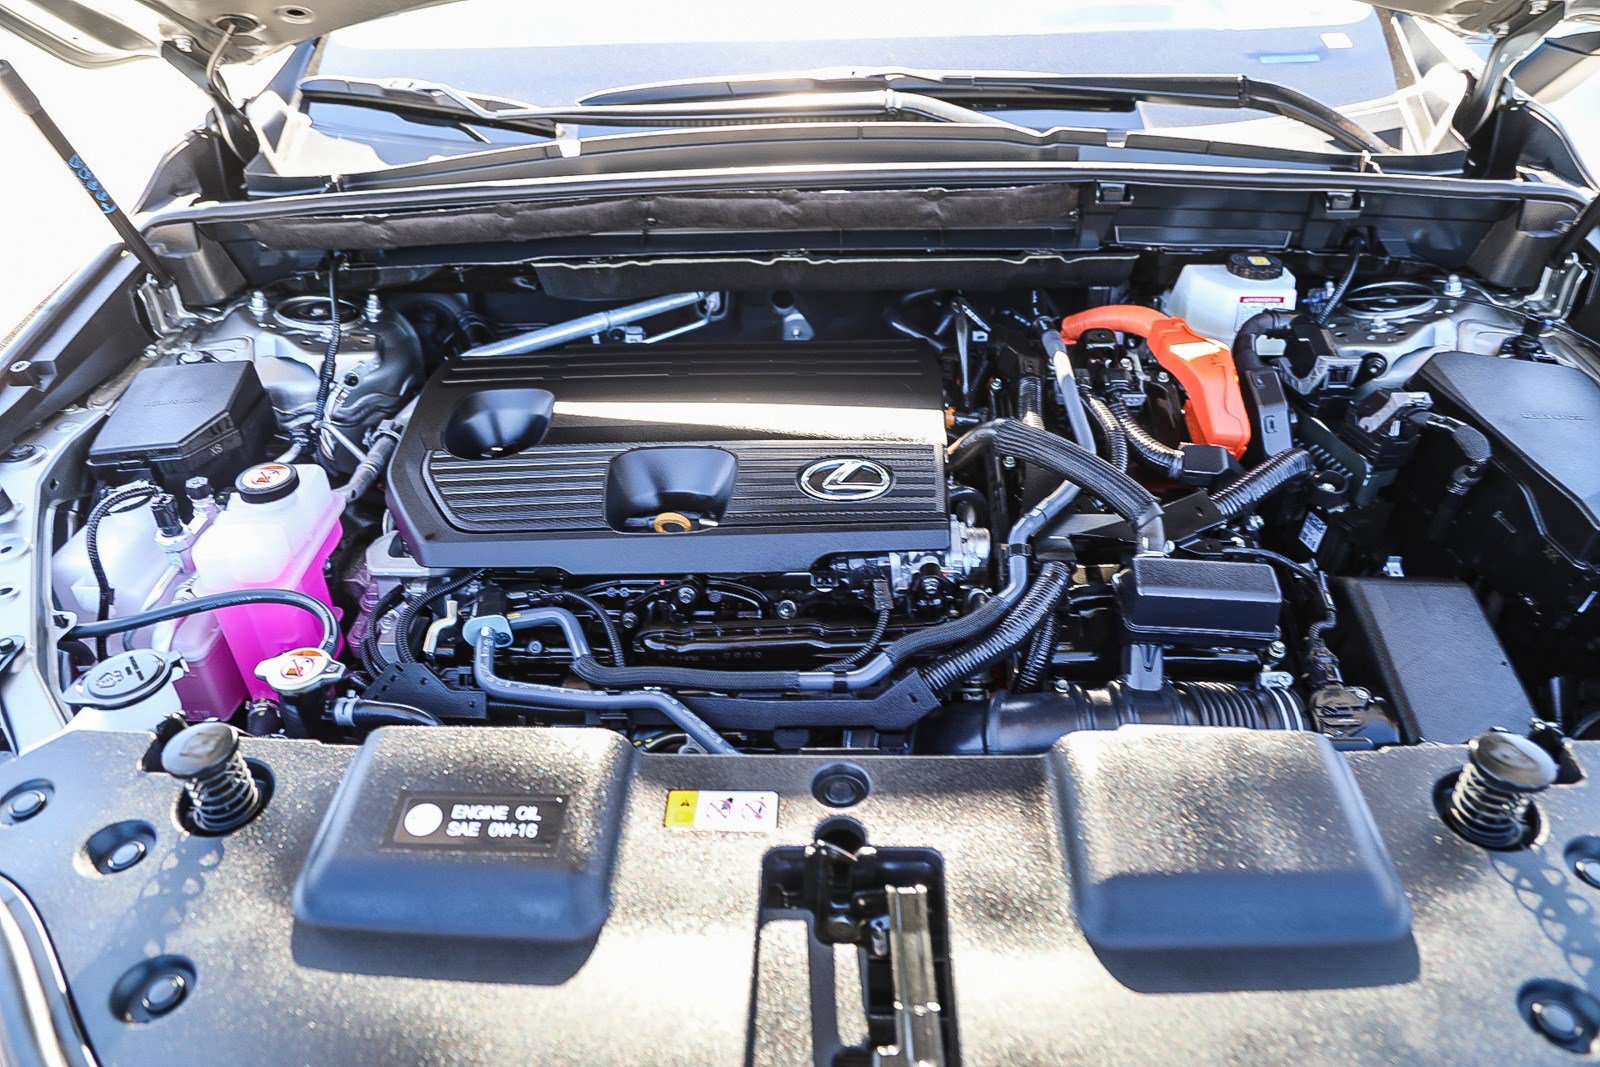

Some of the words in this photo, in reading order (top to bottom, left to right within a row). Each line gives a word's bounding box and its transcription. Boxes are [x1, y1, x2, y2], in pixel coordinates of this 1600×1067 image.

[451, 804, 510, 821] ENGINE
[515, 805, 542, 822] OIL
[446, 820, 482, 837] SAE
[487, 821, 539, 838] 0W-16
